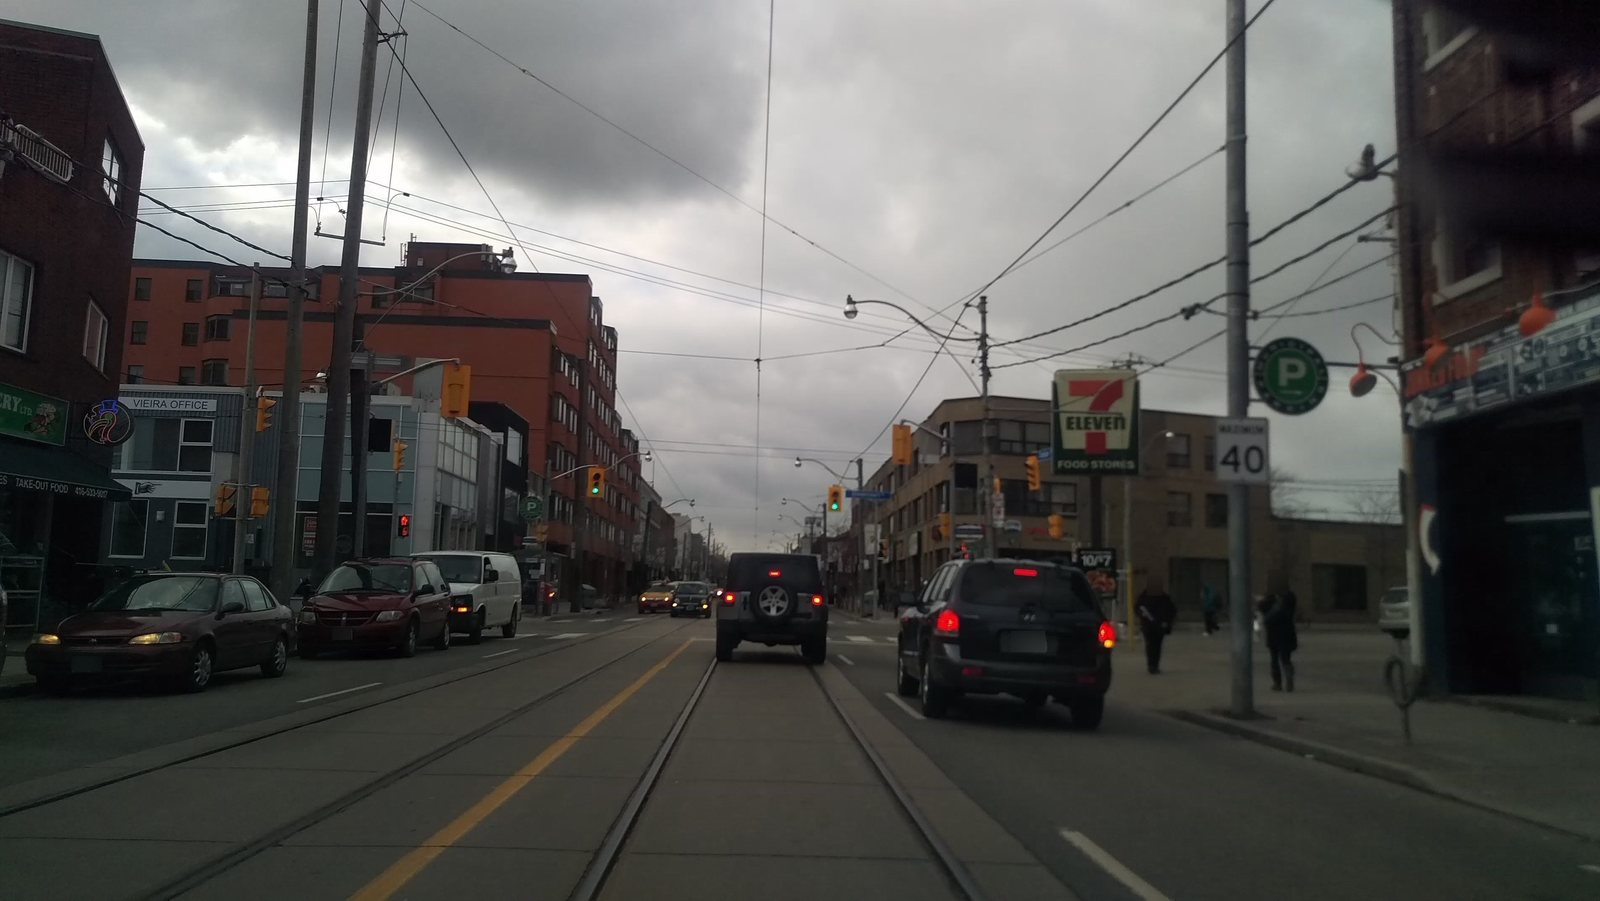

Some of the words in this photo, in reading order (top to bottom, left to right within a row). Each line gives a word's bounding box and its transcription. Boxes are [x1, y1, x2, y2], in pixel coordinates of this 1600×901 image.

[133, 399, 167, 408] VIEIRA
[169, 400, 209, 410] OFFICE
[1056, 459, 1089, 470] FOOD
[1090, 460, 1136, 470] STORES
[1219, 444, 1265, 475] 40
[15, 477, 49, 491] TAKE-OUT
[50, 482, 69, 494] FOOD
